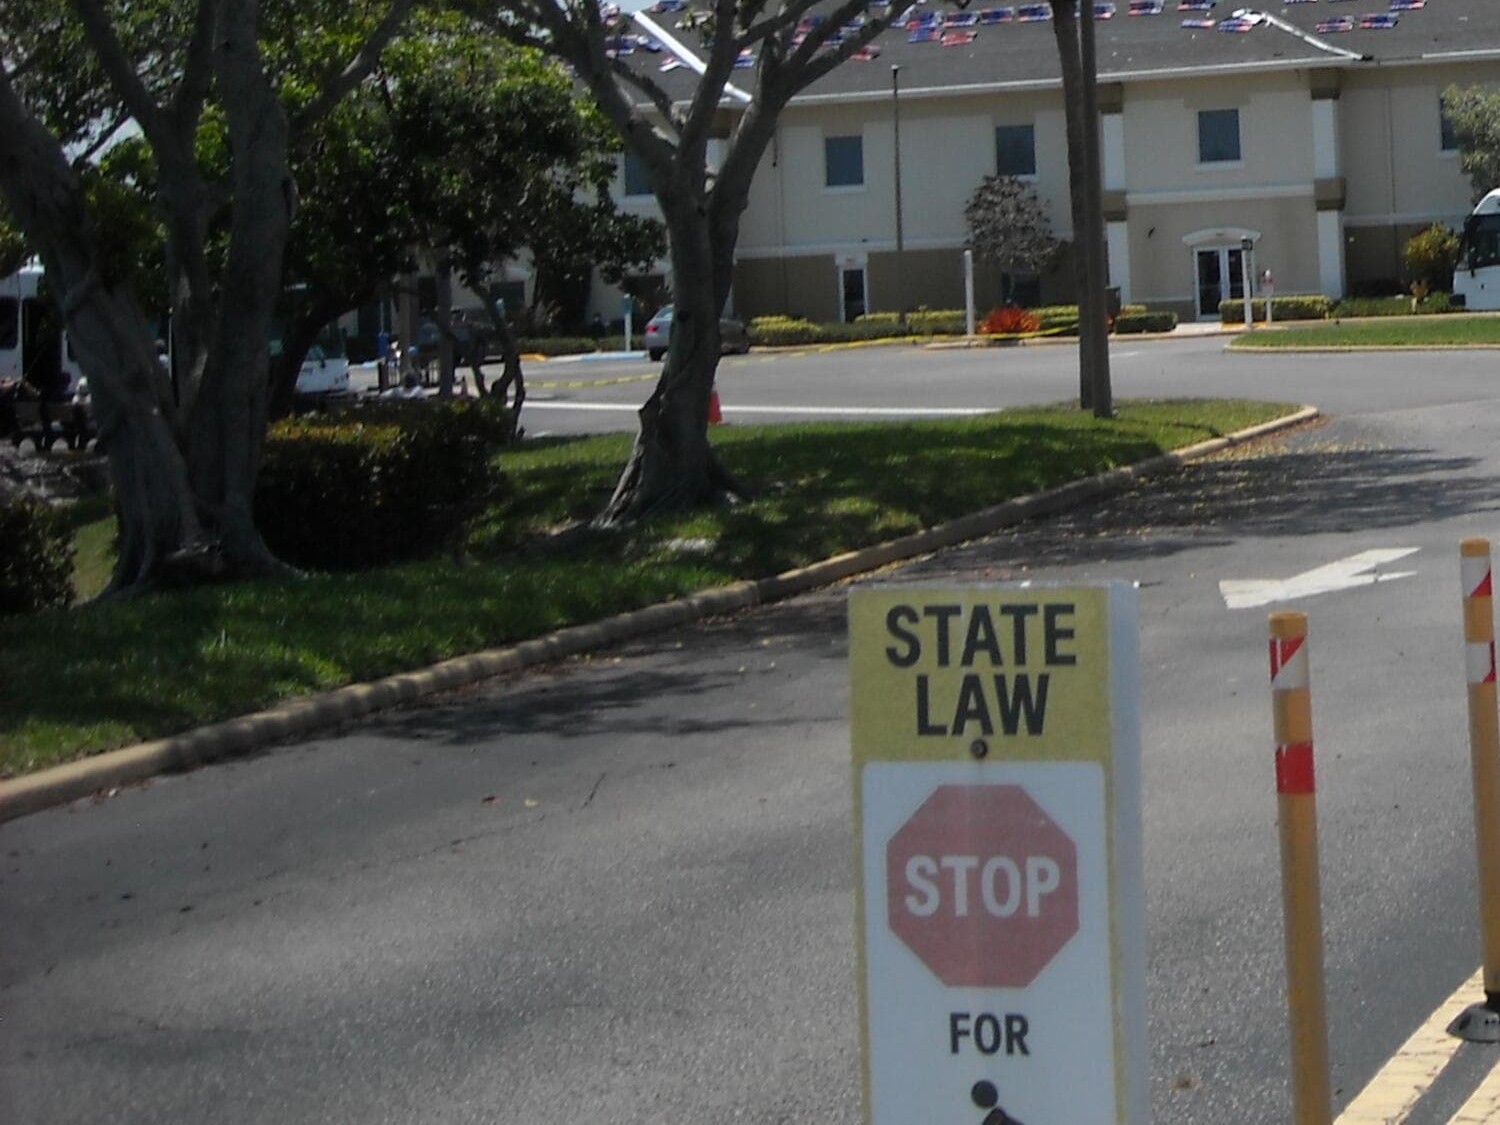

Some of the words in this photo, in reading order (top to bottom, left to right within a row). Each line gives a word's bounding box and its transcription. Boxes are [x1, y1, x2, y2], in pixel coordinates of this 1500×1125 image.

[886, 604, 1077, 666] STATE
[917, 674, 1049, 735] LAW
[905, 856, 1060, 916] STOP
[950, 1013, 1030, 1055] FOR
